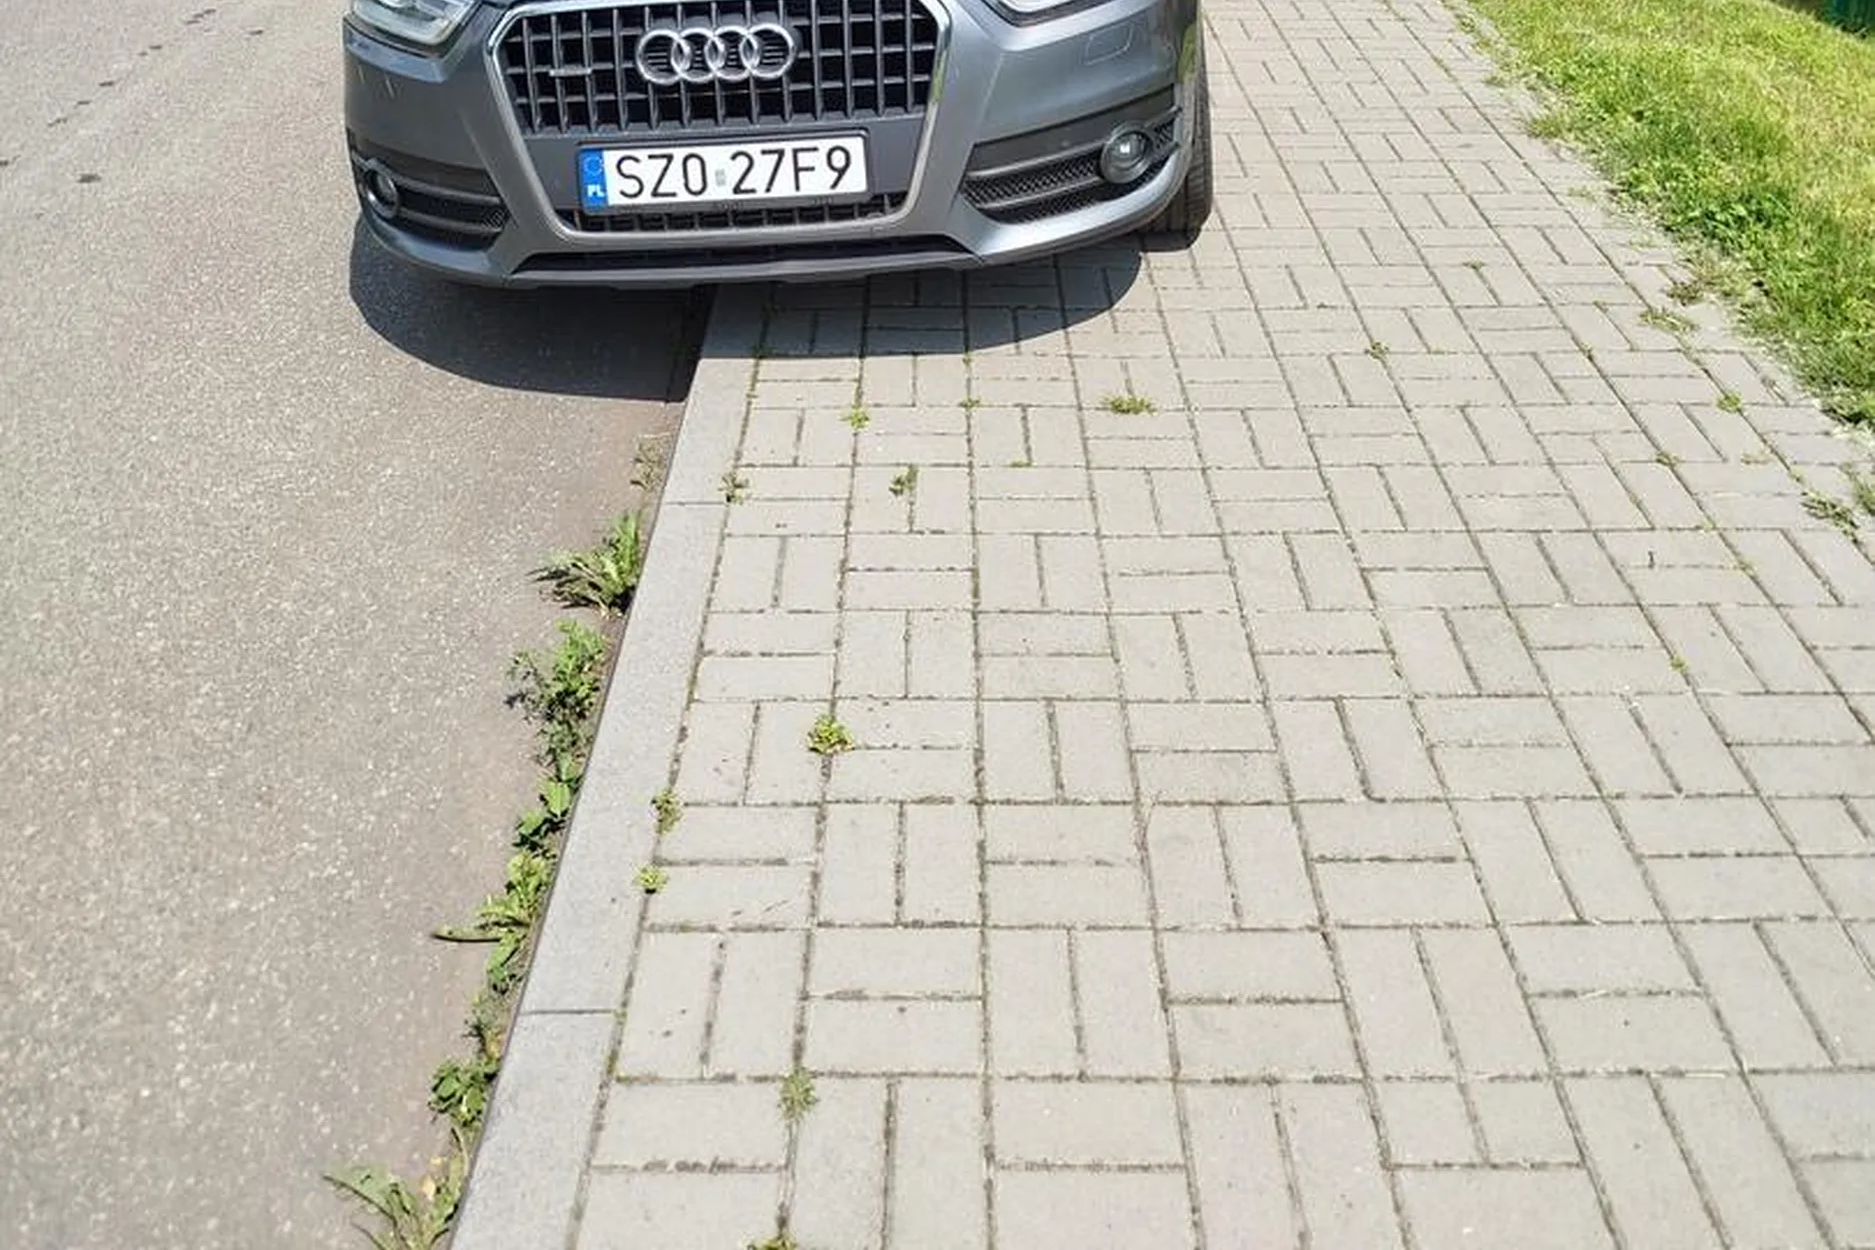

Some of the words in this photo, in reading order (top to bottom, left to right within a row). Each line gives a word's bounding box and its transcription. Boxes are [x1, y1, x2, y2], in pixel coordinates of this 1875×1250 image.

[616, 153, 708, 199] SZO
[730, 145, 852, 195] 27F9
[587, 184, 605, 198] PL
